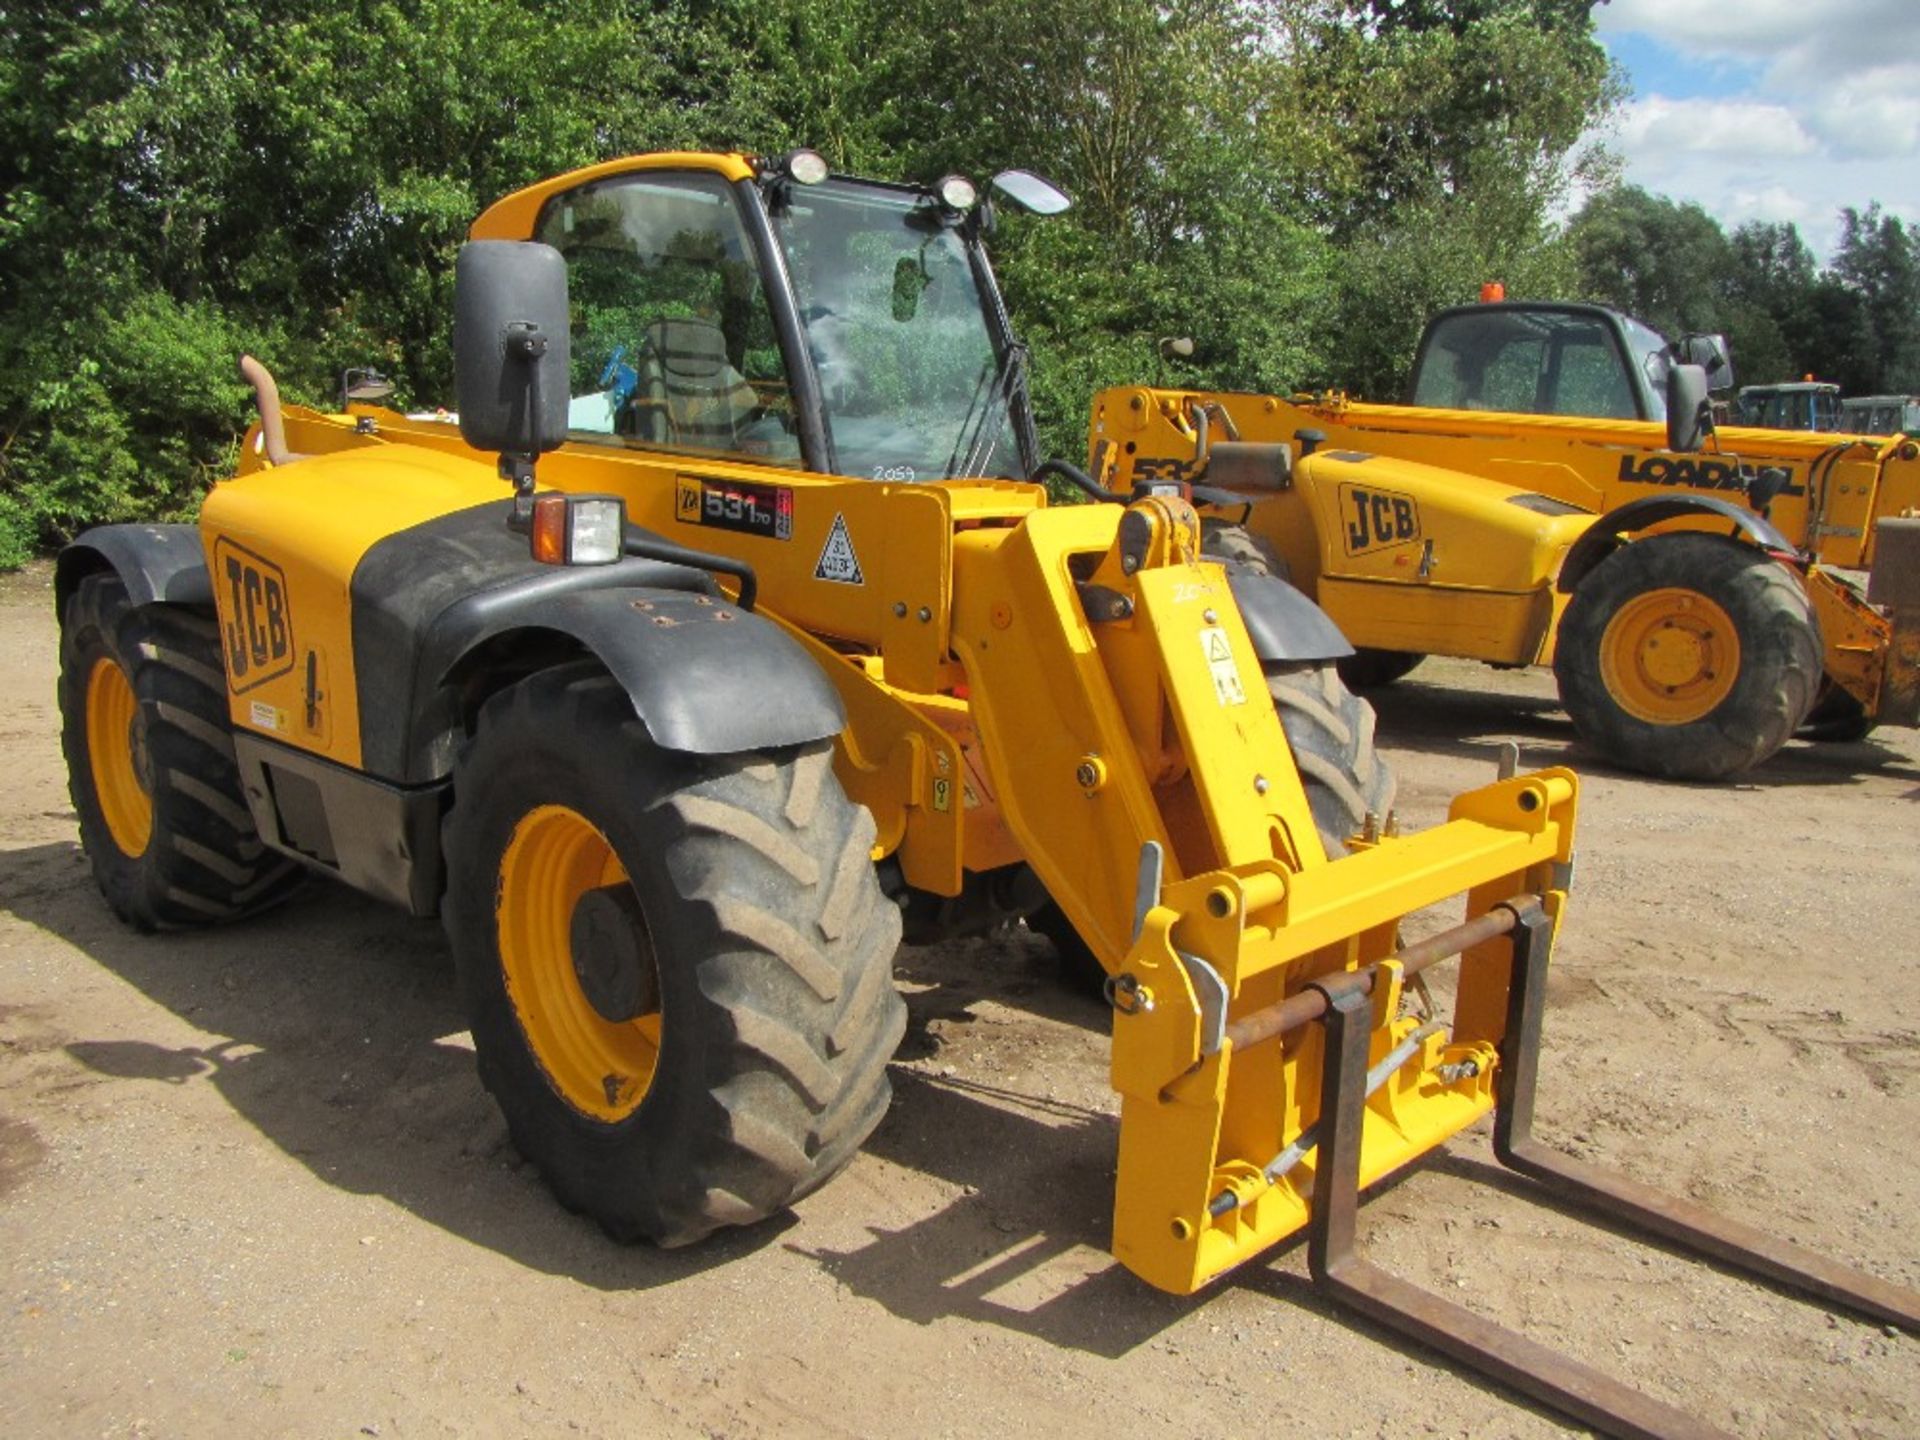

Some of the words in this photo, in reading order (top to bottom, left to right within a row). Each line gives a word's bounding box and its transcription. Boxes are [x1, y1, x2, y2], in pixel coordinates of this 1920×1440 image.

[706, 489, 756, 523] 531
[1349, 490, 1414, 549] JCB
[226, 555, 287, 677] JCB
